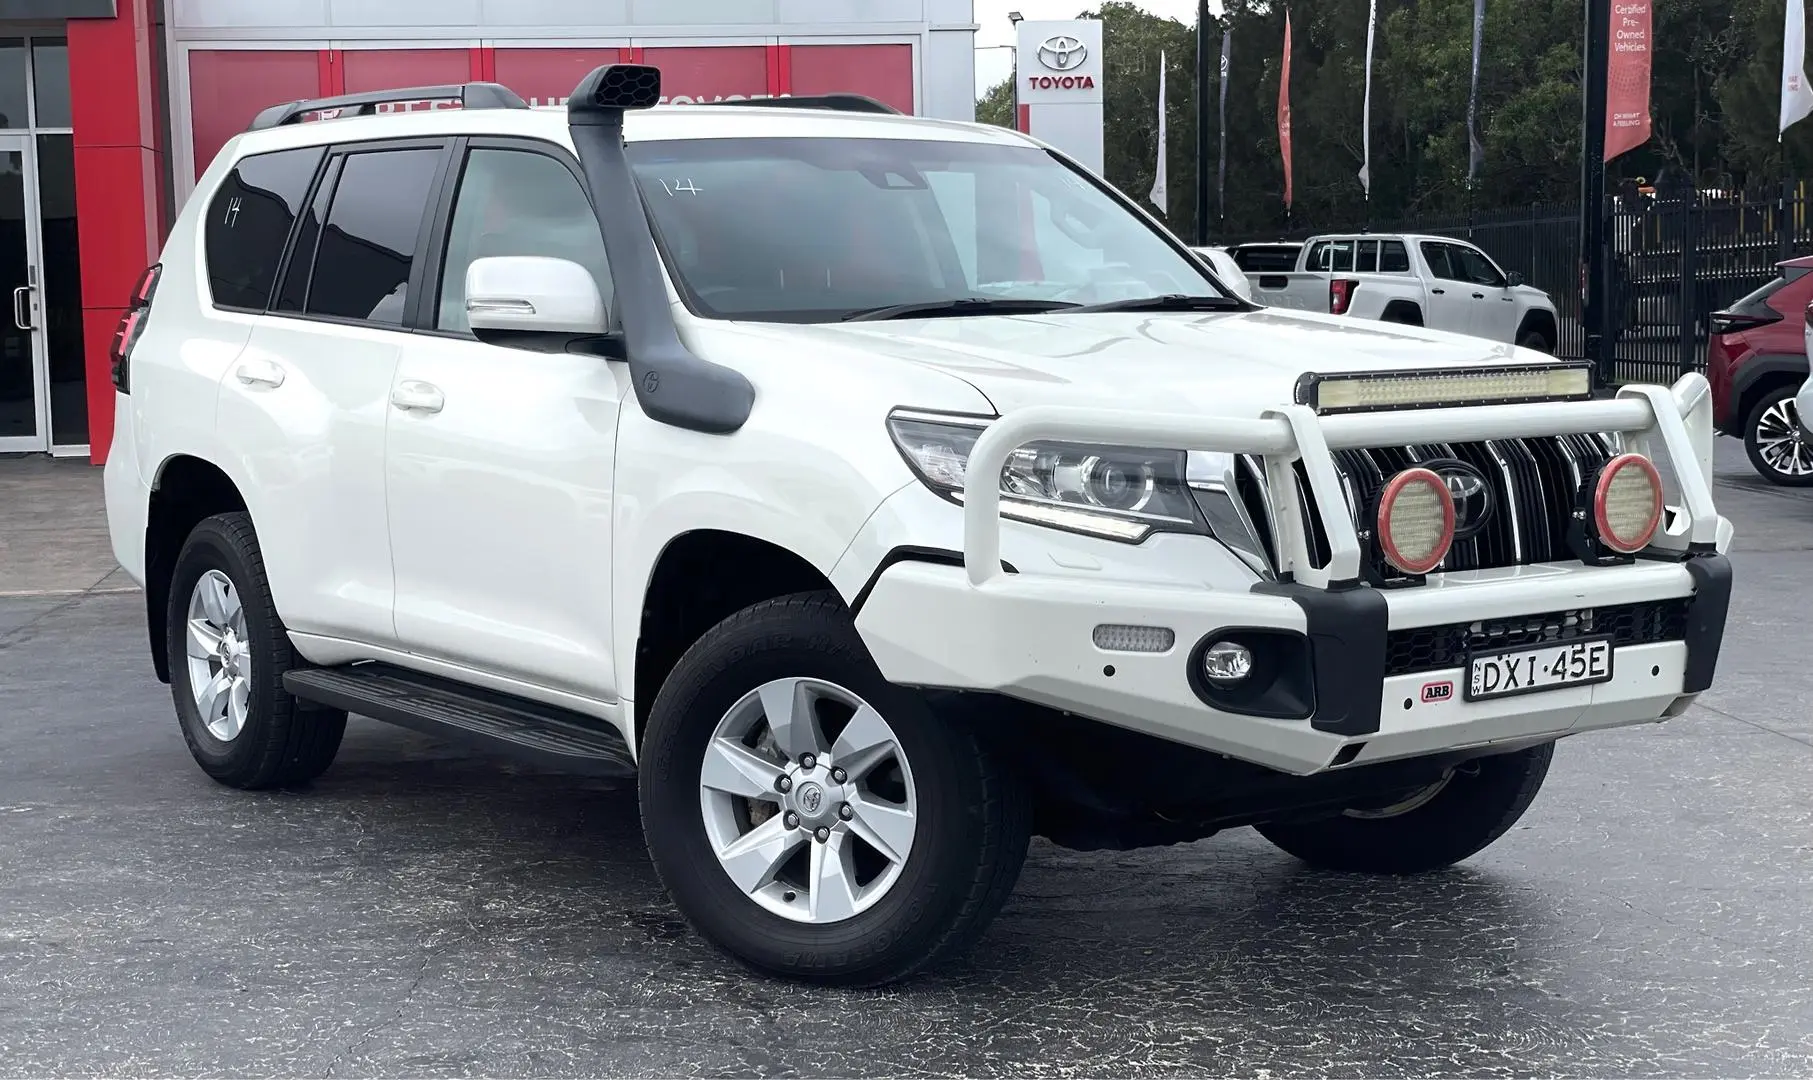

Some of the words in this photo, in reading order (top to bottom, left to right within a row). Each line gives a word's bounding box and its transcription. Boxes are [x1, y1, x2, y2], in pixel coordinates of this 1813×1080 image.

[1616, 29, 1645, 39] Owned
[1614, 41, 1647, 52] Vehicles
[1028, 76, 1094, 90] TOYOTA
[659, 178, 704, 197] 14
[224, 196, 242, 228] 14
[1425, 685, 1450, 699] ARB
